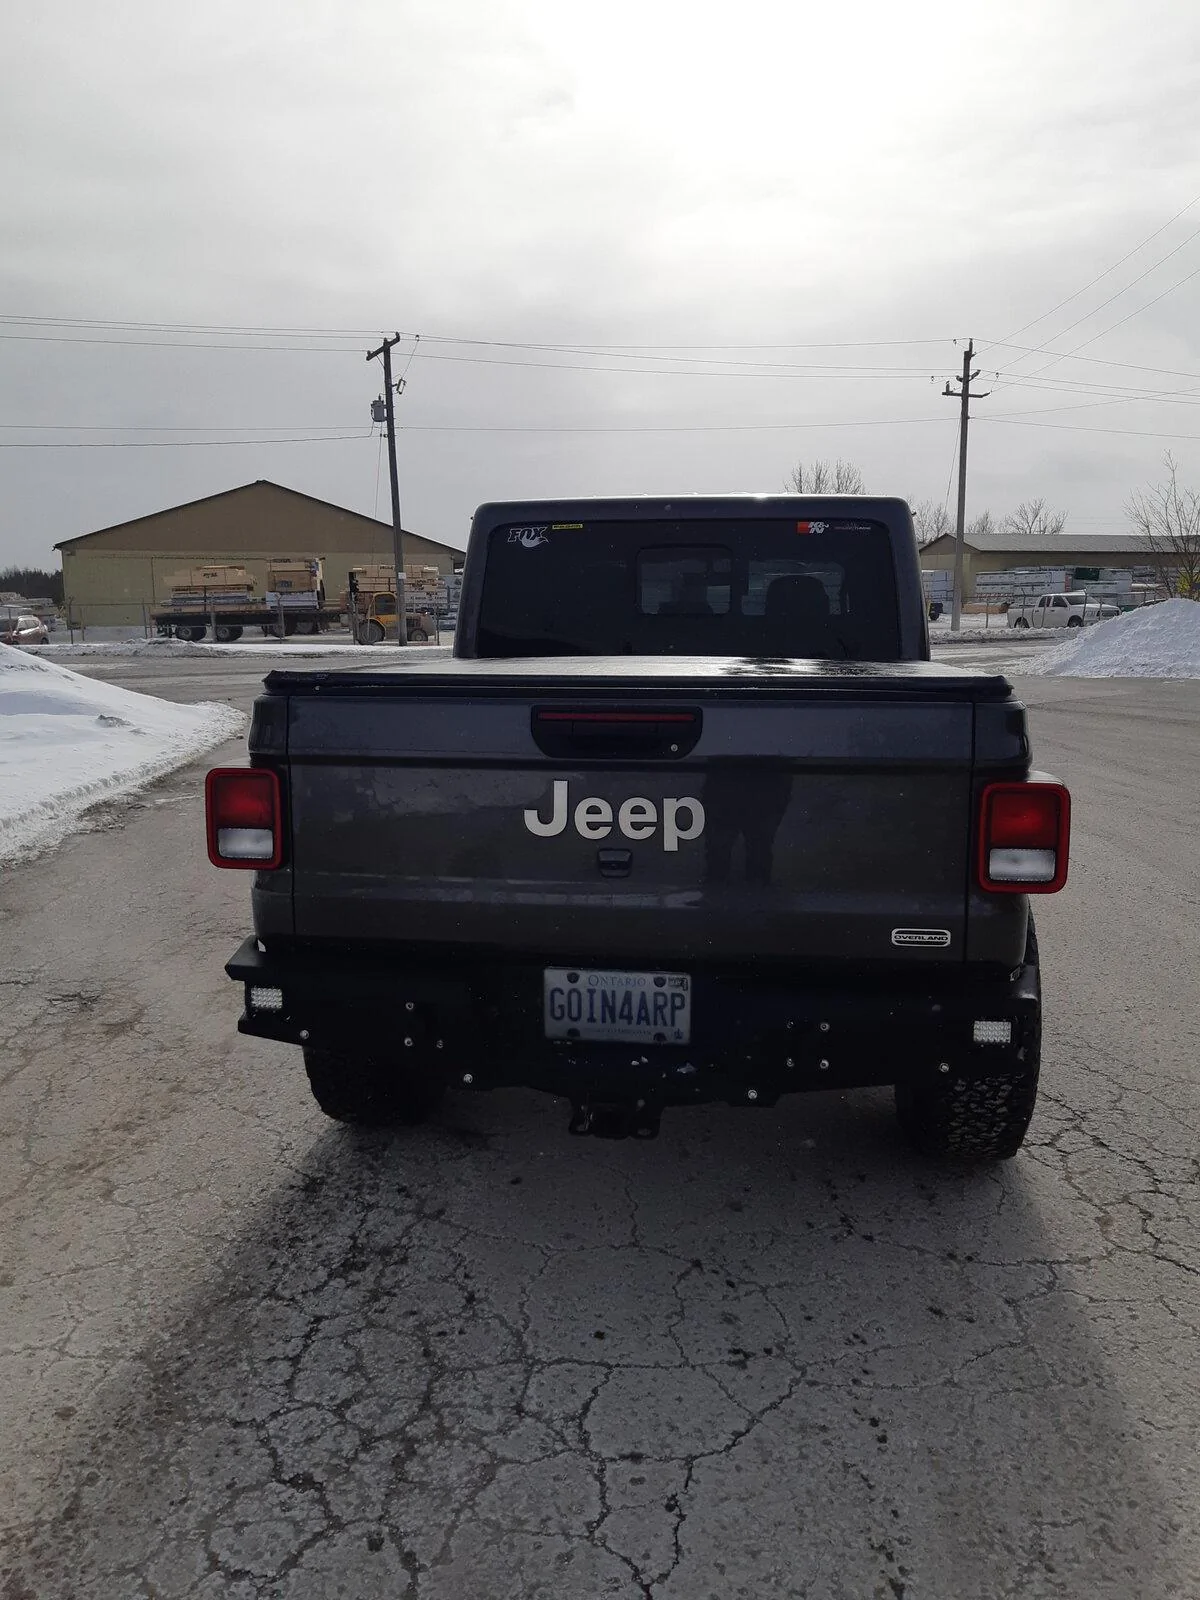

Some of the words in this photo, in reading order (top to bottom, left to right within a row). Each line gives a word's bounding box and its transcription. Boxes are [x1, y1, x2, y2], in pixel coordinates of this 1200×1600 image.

[507, 526, 549, 546] FOX
[523, 780, 706, 852] Jeep
[588, 974, 646, 987] ONTARIO
[550, 987, 686, 1027] GOIN4ARP
